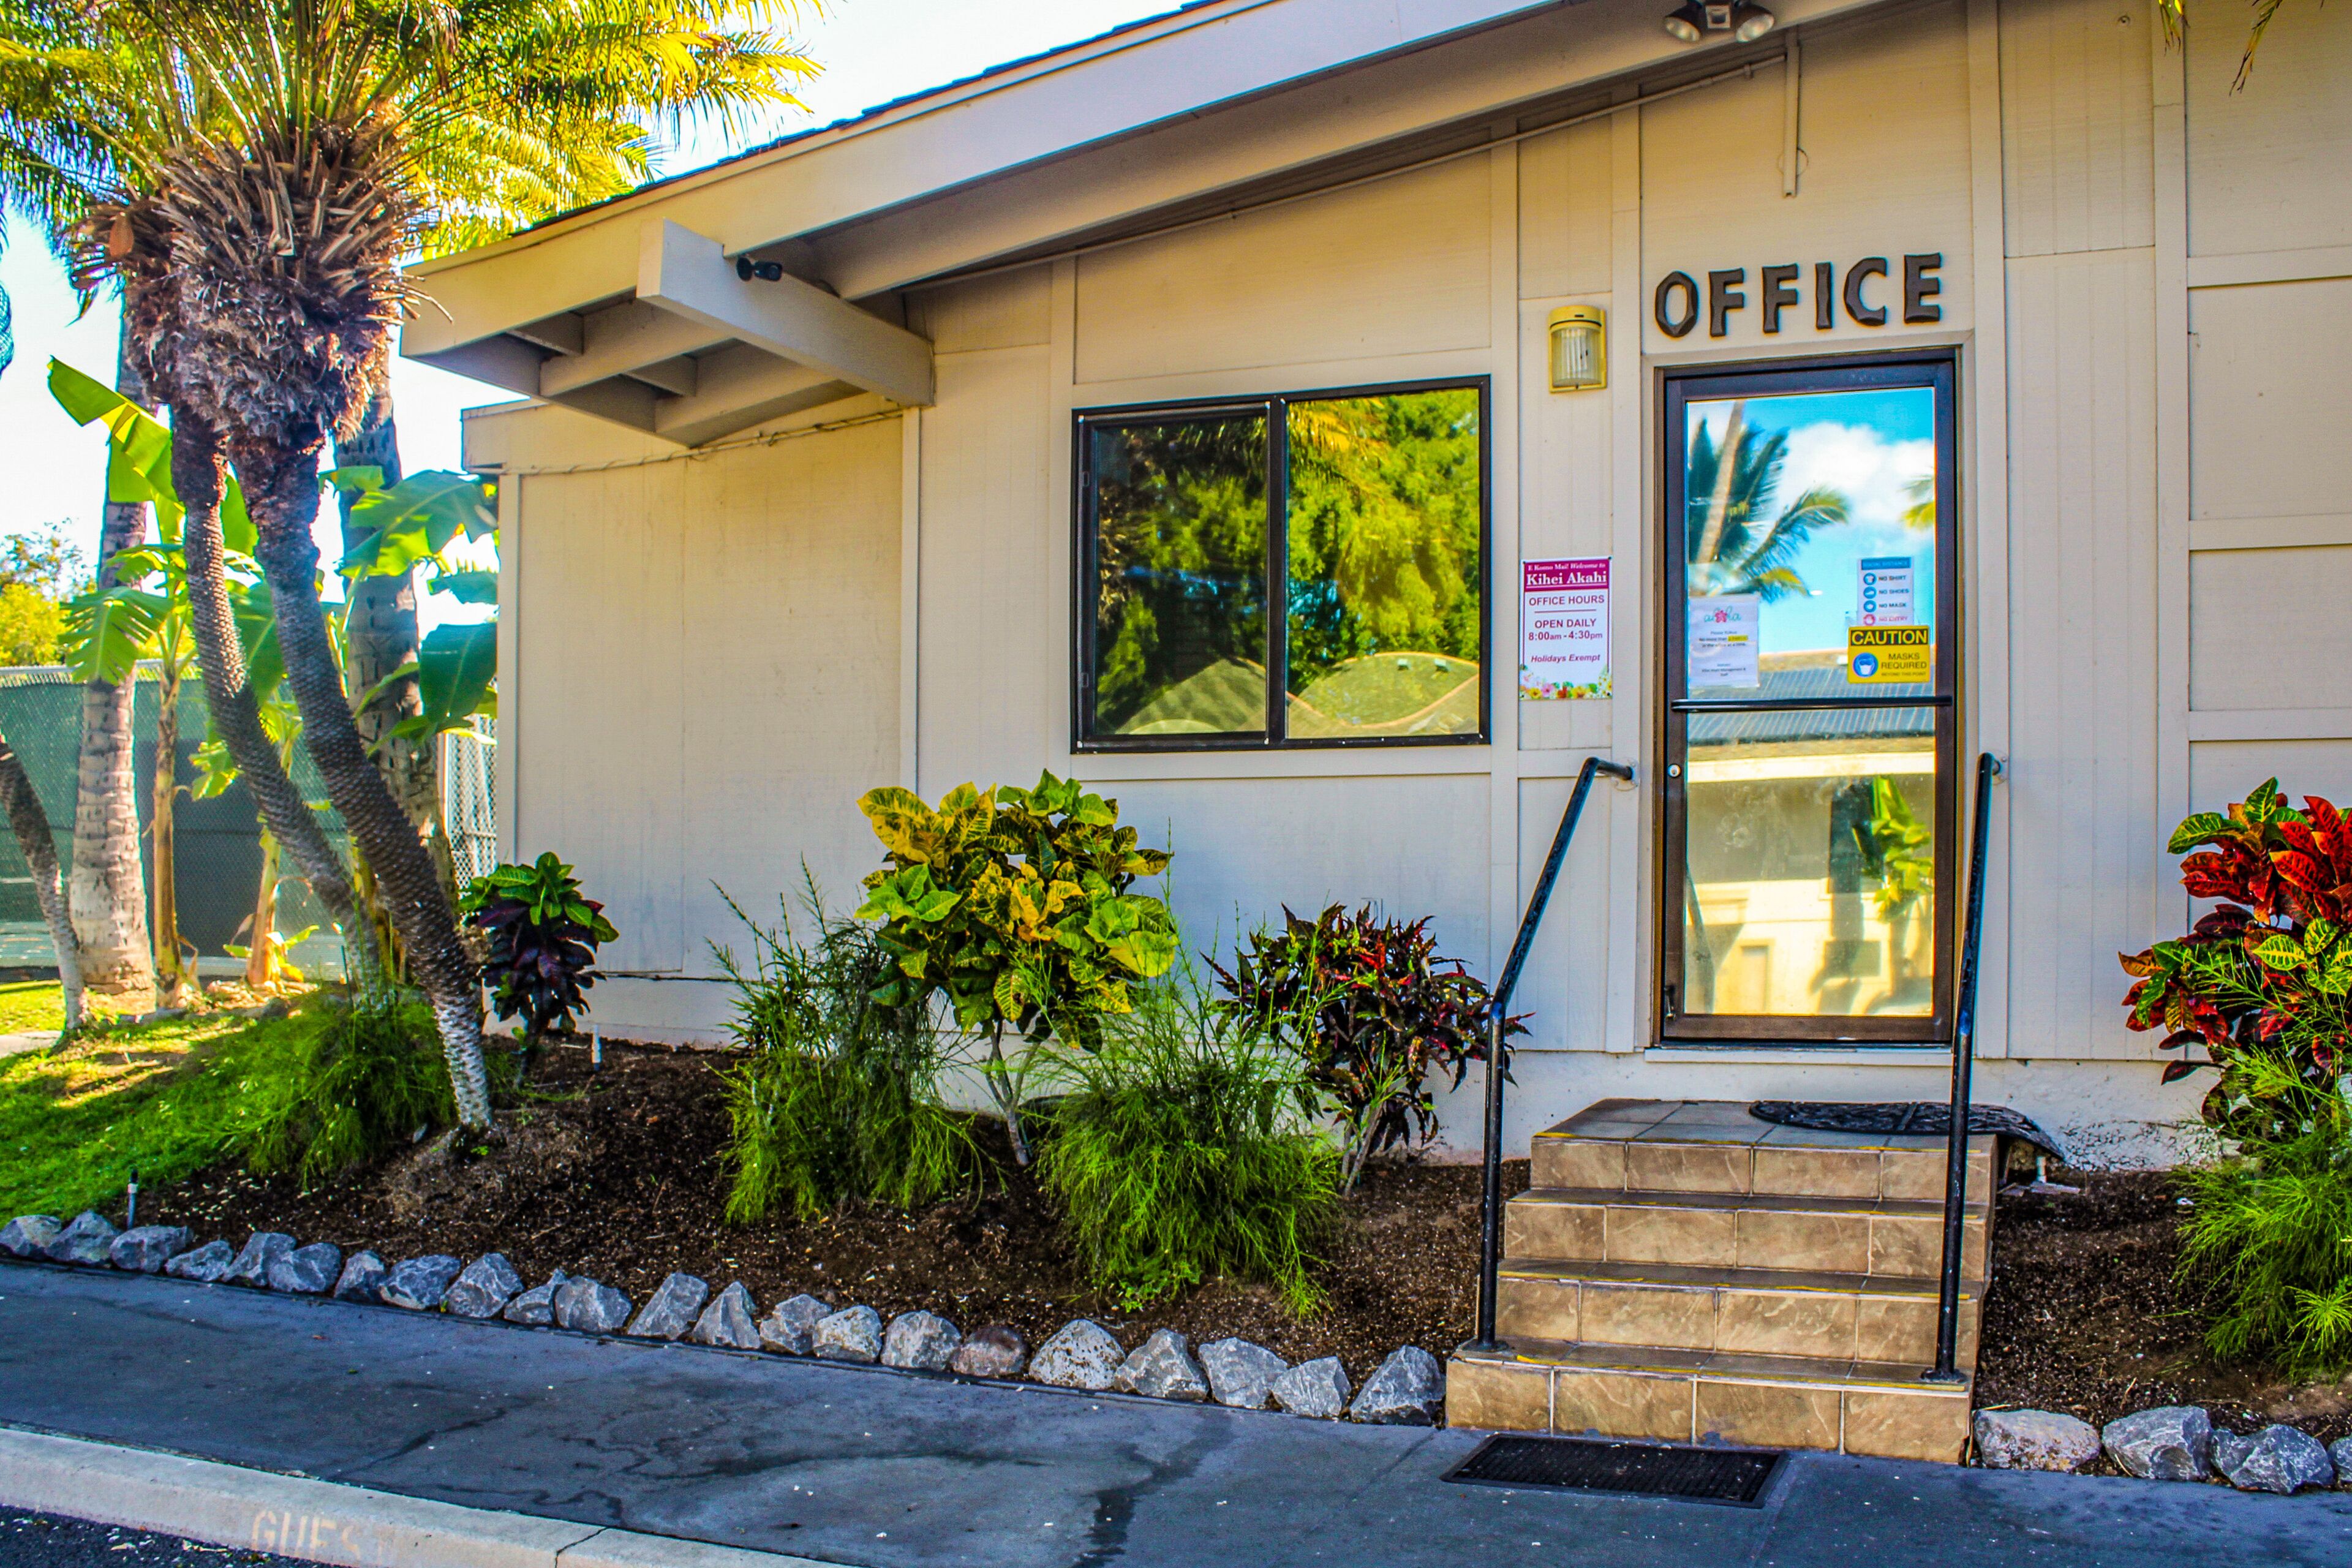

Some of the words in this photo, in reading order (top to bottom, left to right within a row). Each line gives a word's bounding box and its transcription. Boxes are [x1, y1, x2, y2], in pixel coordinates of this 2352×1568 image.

[1654, 252, 1942, 337] OFFICE
[1527, 572, 1563, 586] Kihei
[1566, 570, 1607, 584] Akahi
[1529, 596, 1565, 606] OFFICE
[1568, 595, 1604, 605] HOURS
[1705, 605, 1741, 622] alha
[1535, 620, 1563, 628] OPEN
[1567, 618, 1596, 628] DAILY
[1852, 630, 1928, 645] CAUTION
[1531, 654, 1566, 663] Holidays
[1569, 654, 1600, 663] Exempt
[1881, 661, 1927, 669] REQUIRED
